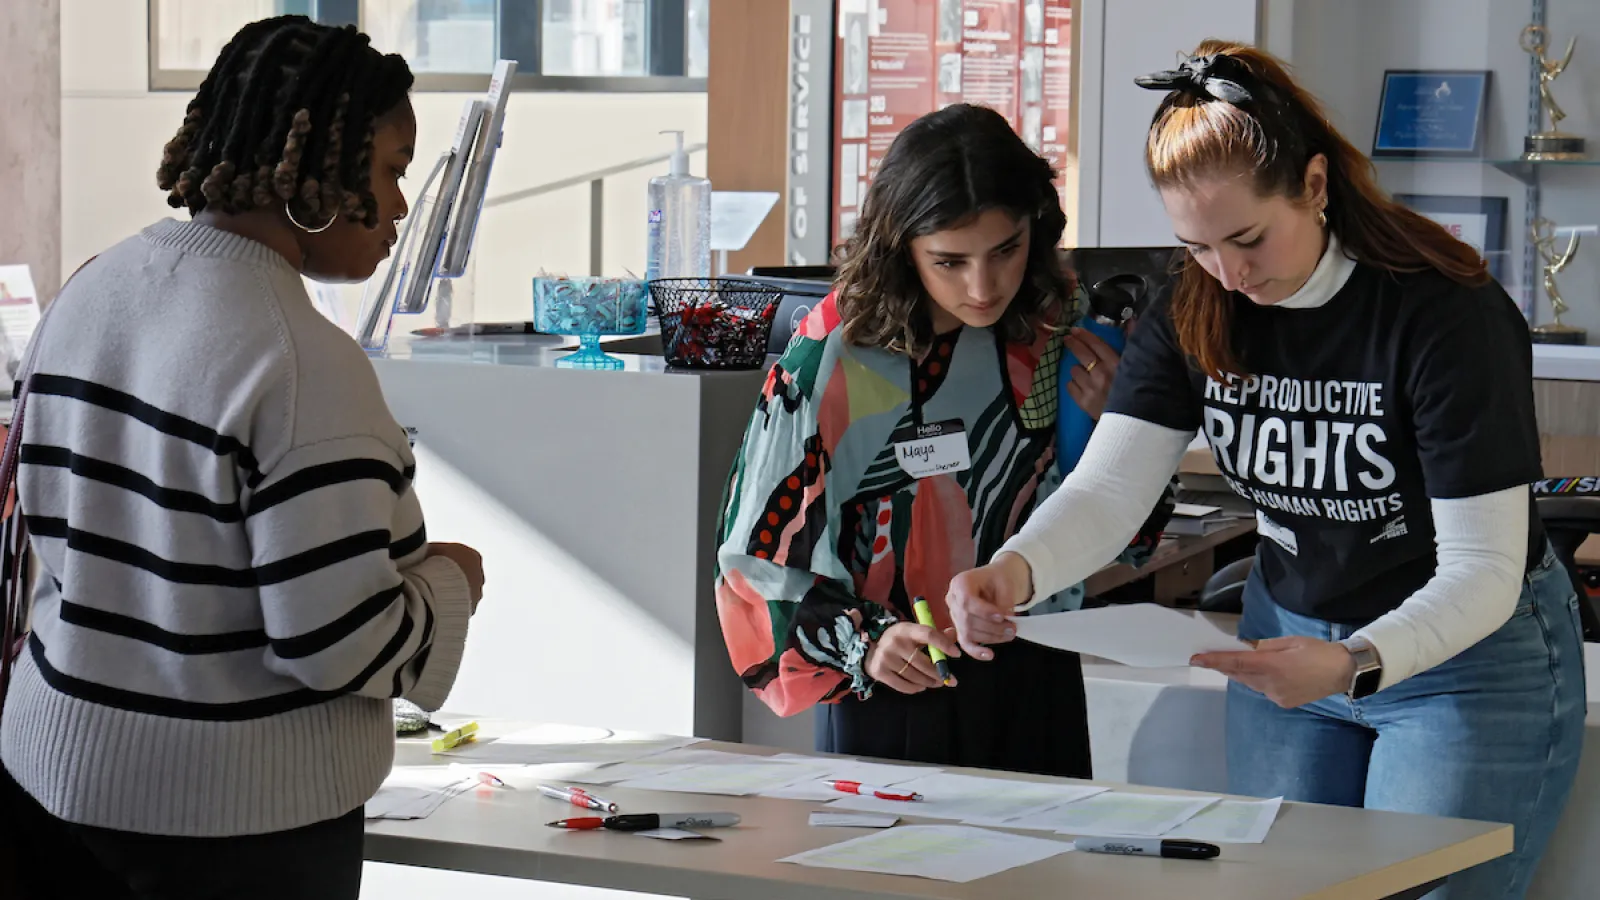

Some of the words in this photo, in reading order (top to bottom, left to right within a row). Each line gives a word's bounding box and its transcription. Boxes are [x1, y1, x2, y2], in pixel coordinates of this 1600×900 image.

[795, 15, 811, 175] SERVICE
[795, 187, 807, 238] OF
[1204, 369, 1385, 416] REPRODUCTIVE
[902, 444, 935, 462] Maya
[917, 424, 942, 435] Hello
[1203, 405, 1397, 491] RIGHTS
[1223, 474, 1252, 500] RE
[1248, 486, 1321, 516] HUMAN
[1321, 492, 1404, 522] RIGHTS
